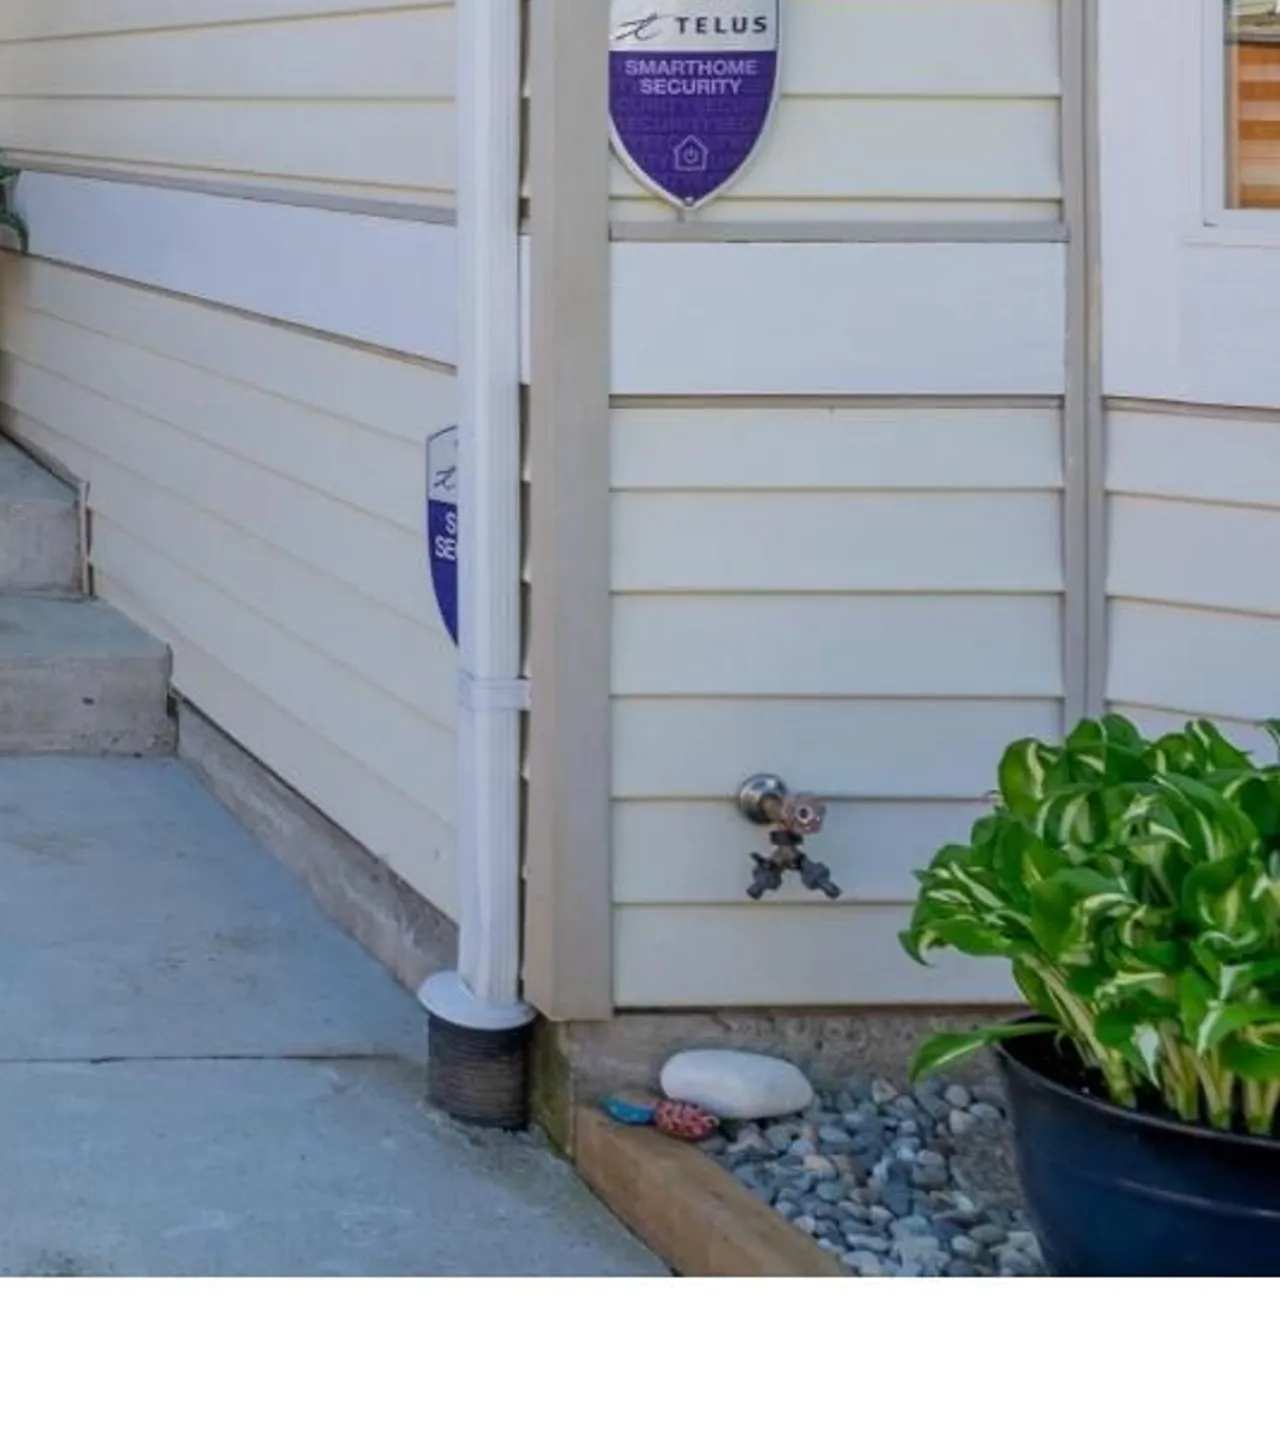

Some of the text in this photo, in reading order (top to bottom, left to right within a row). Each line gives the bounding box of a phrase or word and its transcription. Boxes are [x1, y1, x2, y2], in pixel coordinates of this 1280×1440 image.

[675, 16, 768, 35] TELUS
[624, 59, 759, 76] SMARTHOME
[641, 78, 743, 95] SECURITY
